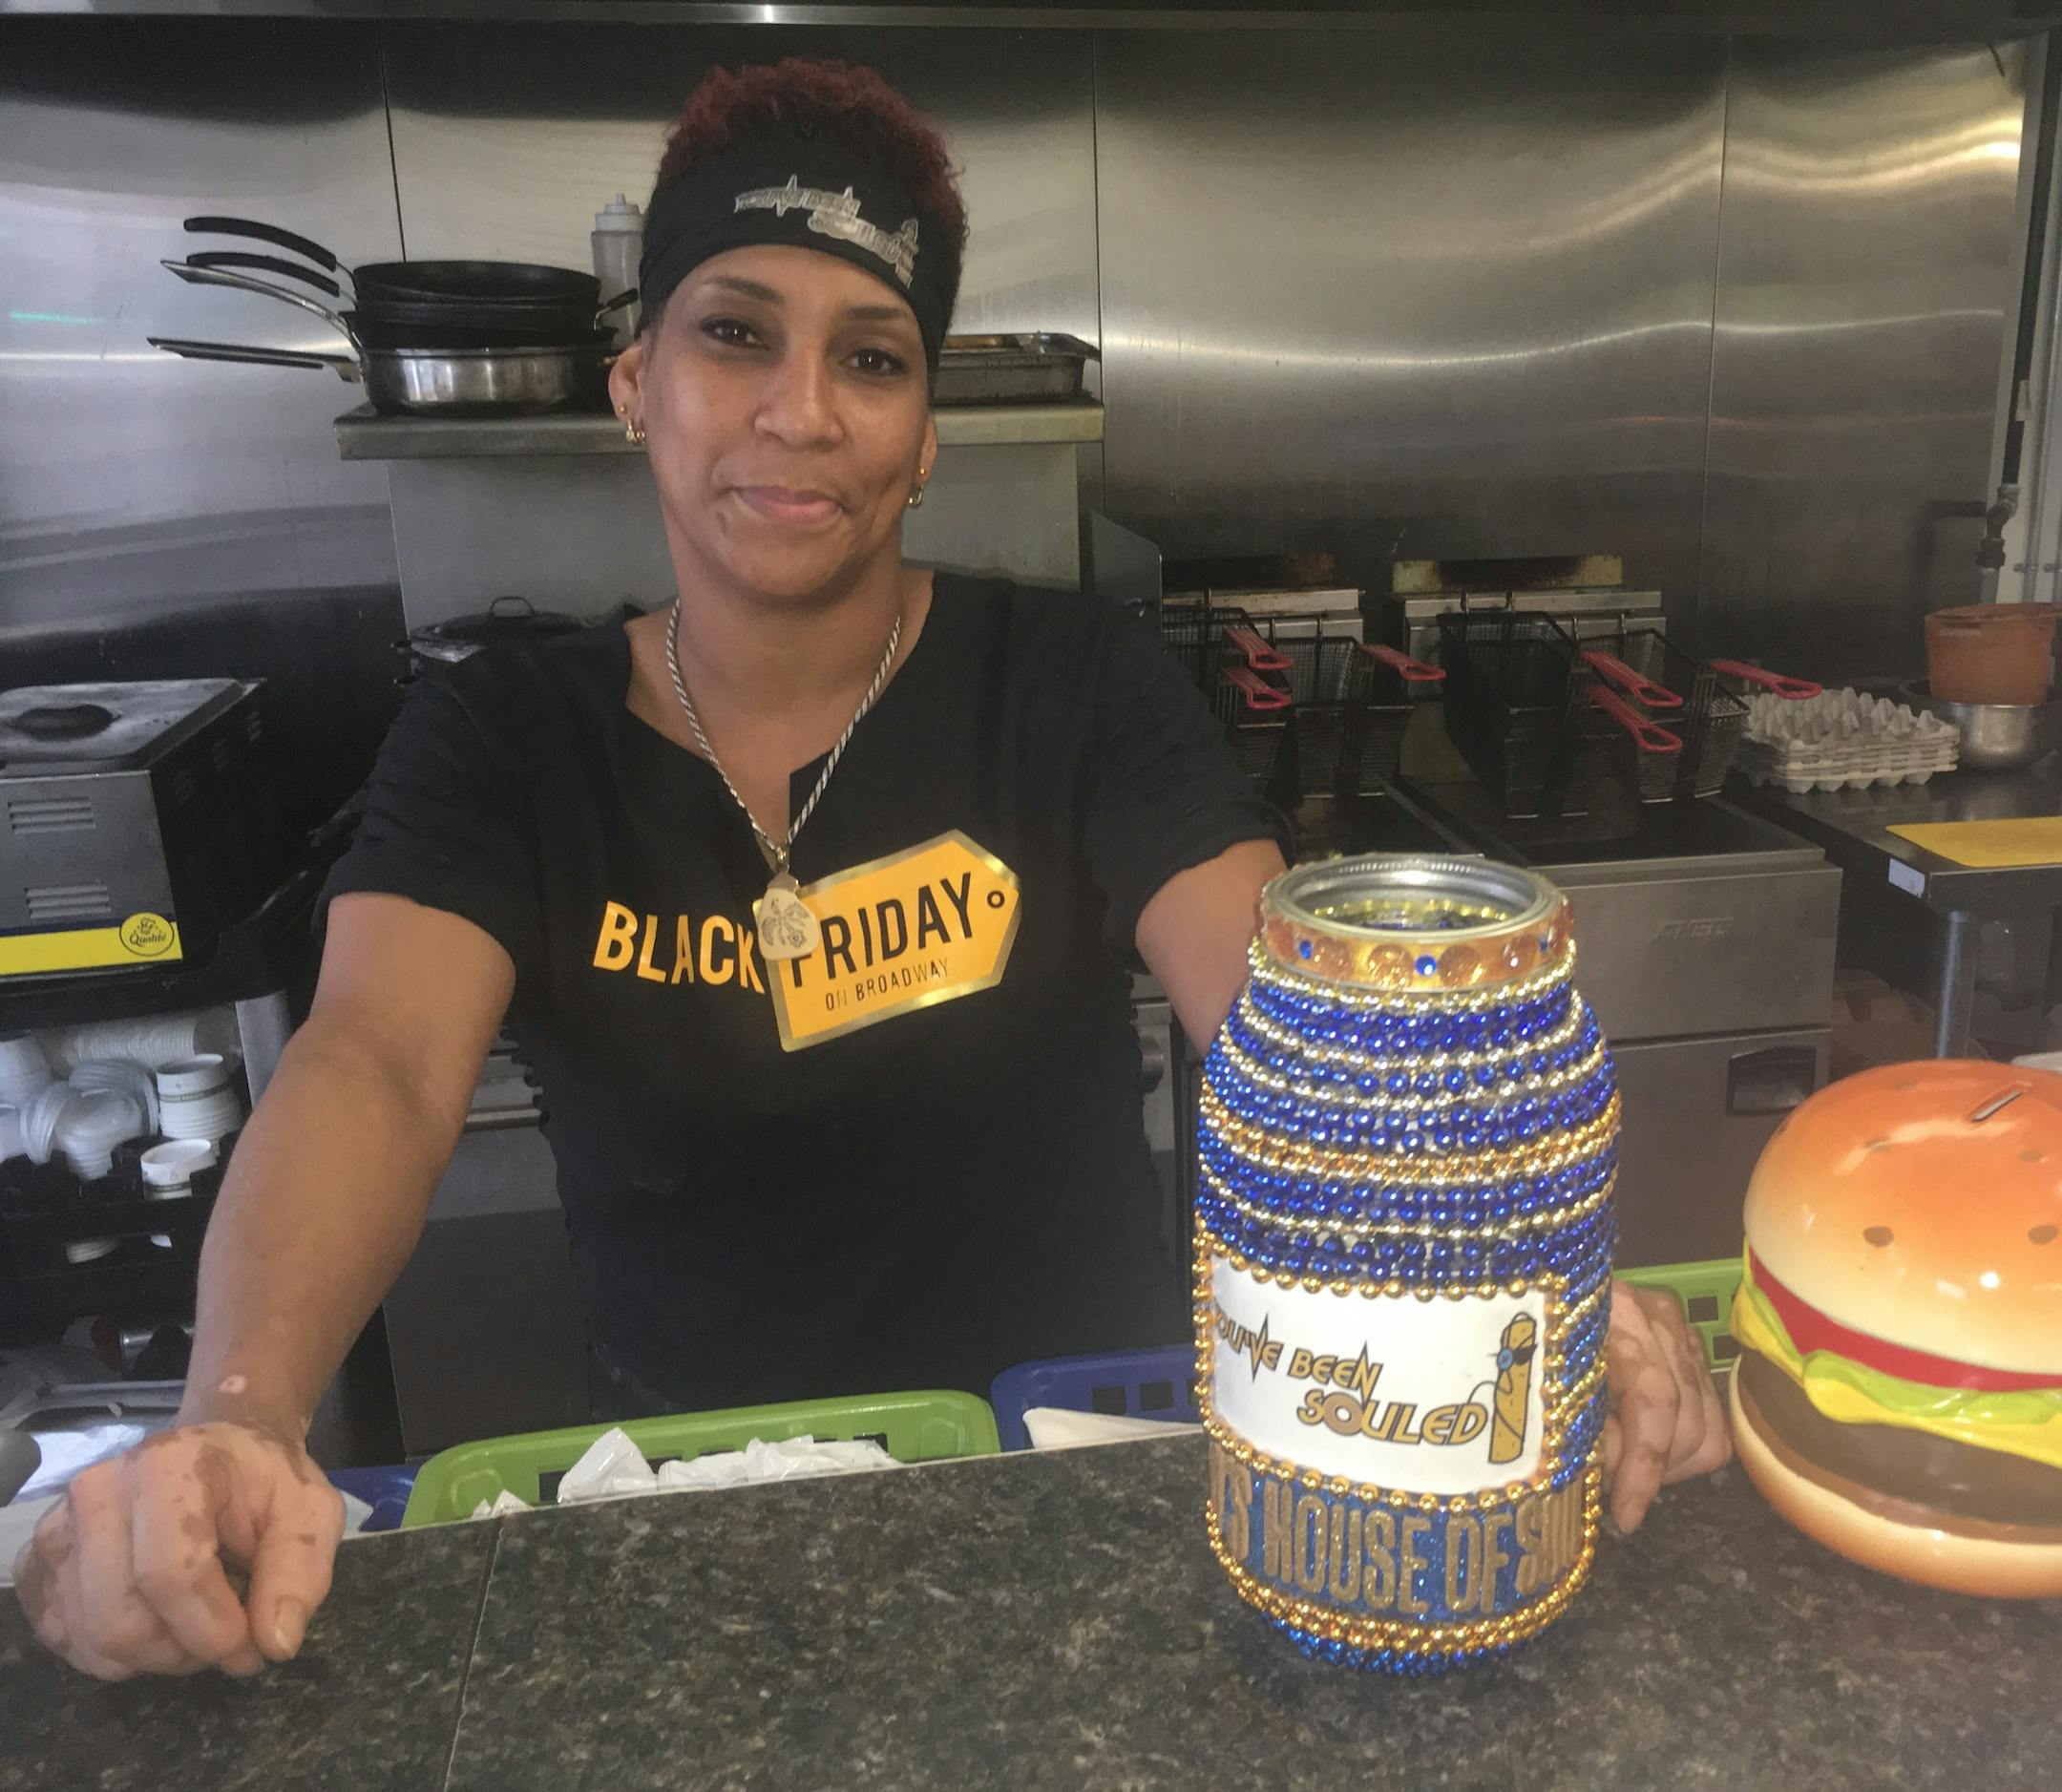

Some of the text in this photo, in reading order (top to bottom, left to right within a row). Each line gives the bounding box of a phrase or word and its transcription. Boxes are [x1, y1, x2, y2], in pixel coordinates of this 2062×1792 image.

[593, 900, 764, 994] BLACK
[826, 957, 949, 1011] ON BROADWAY
[1287, 1340, 1384, 1402] BEEN
[1296, 1388, 1489, 1446] SOULED
[1263, 1480, 1432, 1613] HOUSE
[1445, 1511, 1514, 1613] OF
